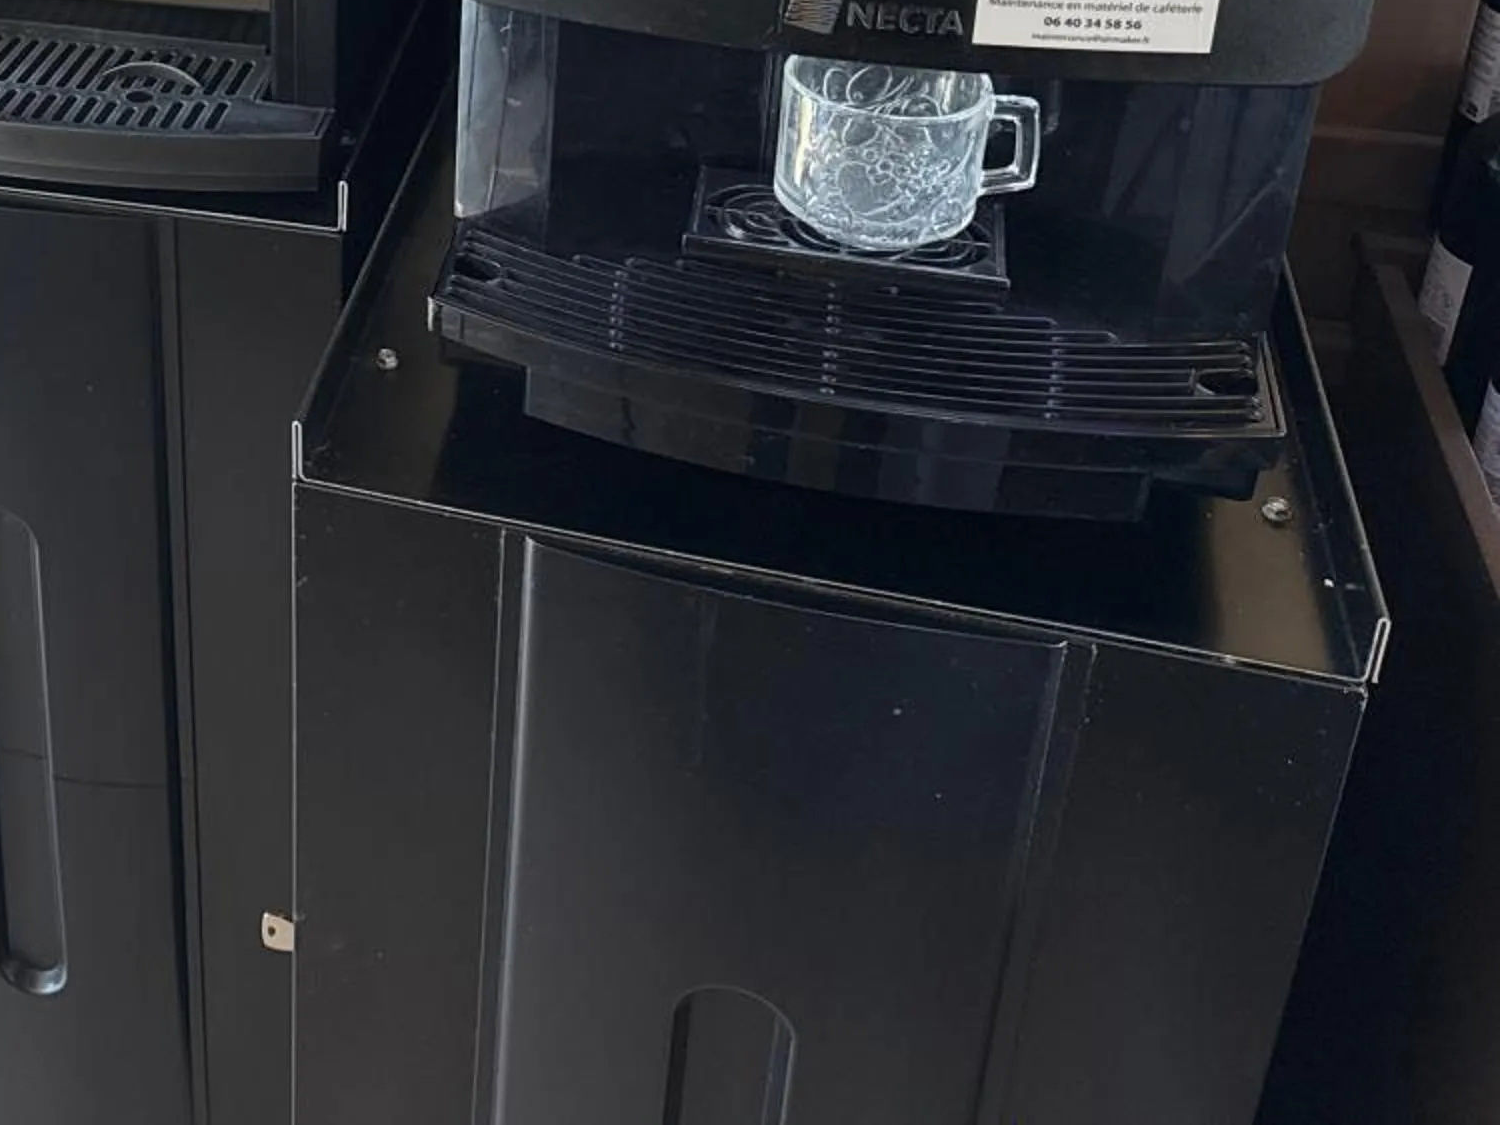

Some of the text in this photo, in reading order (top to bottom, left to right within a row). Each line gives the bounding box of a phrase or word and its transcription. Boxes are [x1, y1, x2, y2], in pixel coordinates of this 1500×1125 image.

[1066, 2, 1082, 11] en
[846, 0, 964, 35] NECTA
[1043, 16, 1061, 27] 06
